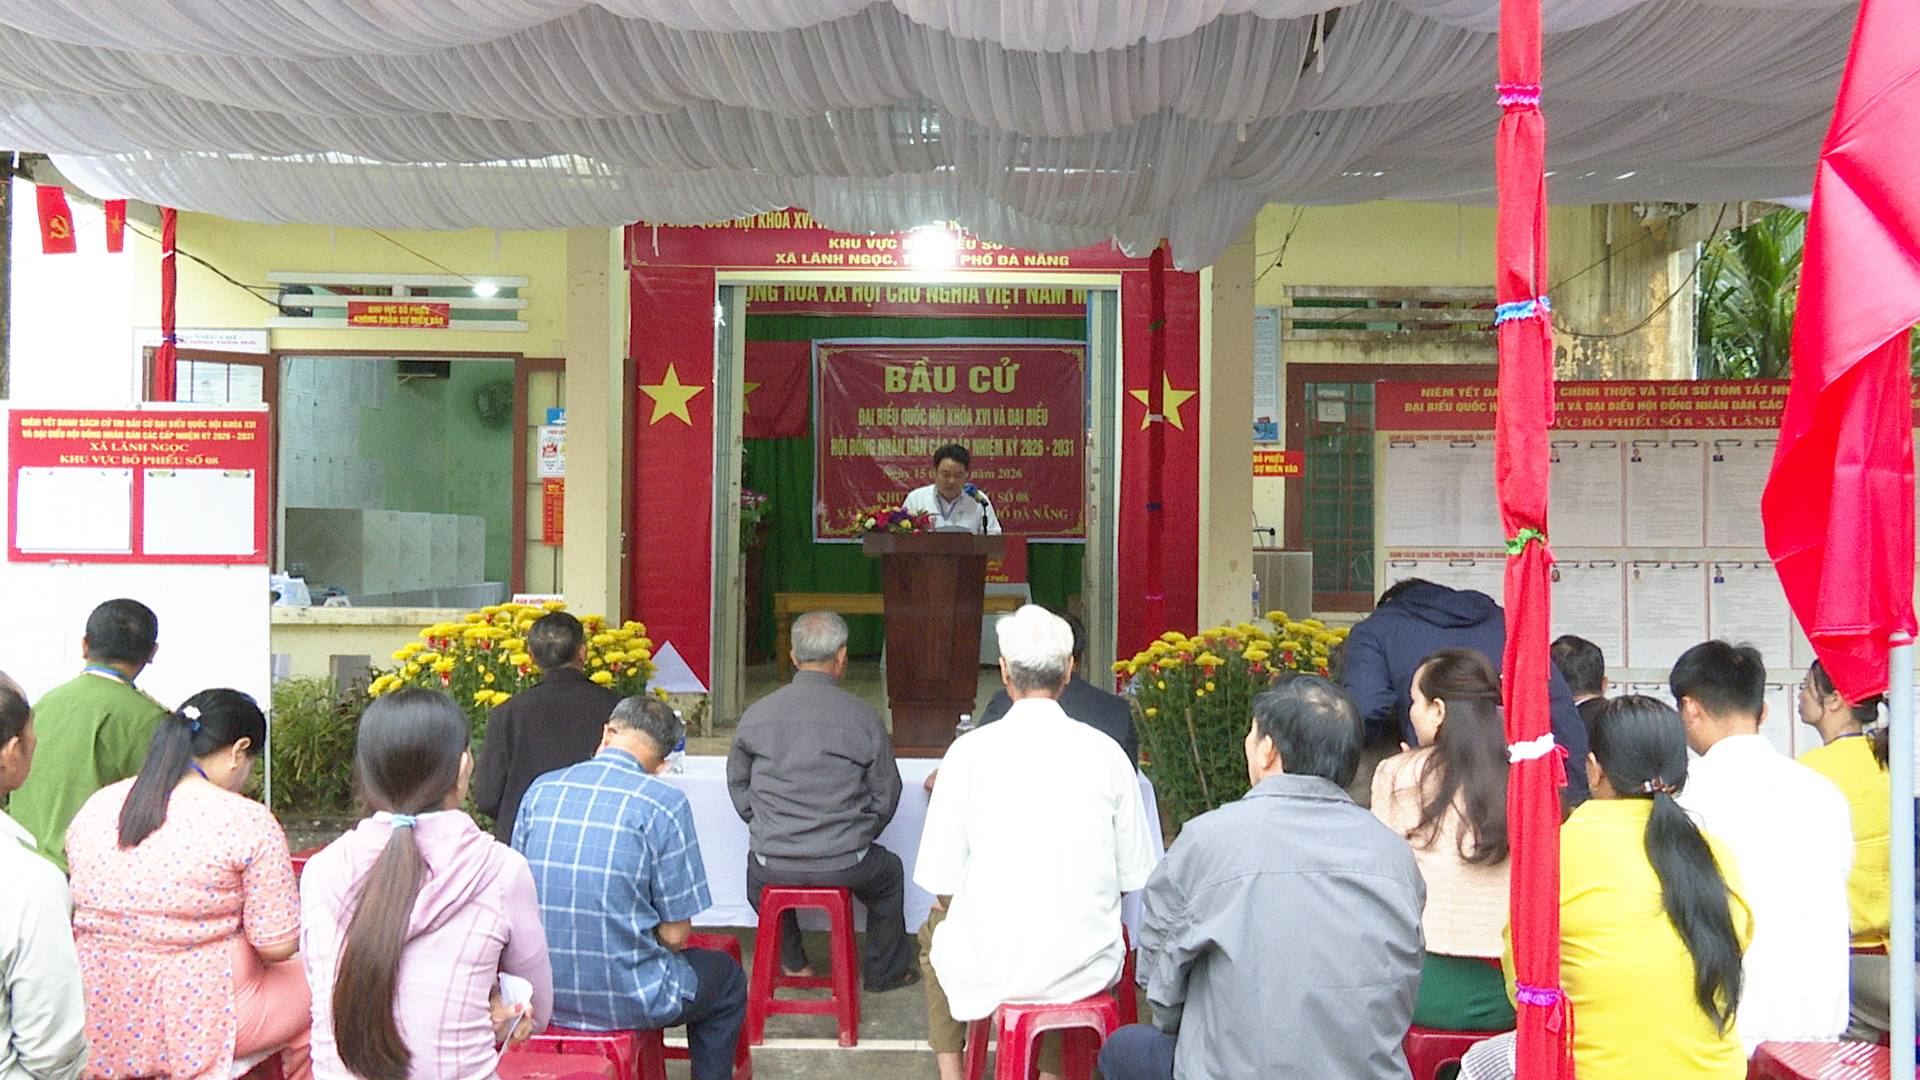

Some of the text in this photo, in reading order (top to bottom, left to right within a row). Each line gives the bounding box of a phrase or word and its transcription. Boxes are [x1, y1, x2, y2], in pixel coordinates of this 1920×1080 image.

[829, 238, 861, 249] KHU
[866, 237, 898, 251] VỰC
[775, 251, 797, 264] XÃ
[960, 251, 993, 266] PHỐ
[997, 253, 1020, 266] ĐÀ
[1026, 287, 1067, 304] NAM
[884, 356, 1021, 393] BẦU CỬ
[1421, 385, 1453, 397] NIÊM
[1458, 384, 1480, 397] YẾT
[1560, 384, 1600, 397] CHÍNH
[1604, 385, 1636, 396] THỨC
[1639, 385, 1656, 396] VÀ
[1661, 382, 1688, 396] TIỂU
[1712, 384, 1741, 395] TÓM
[1404, 401, 1424, 413] ĐẠI
[1427, 399, 1453, 412] BIỂU
[1456, 400, 1486, 412] QUỐC
[1567, 399, 1582, 411] VÀ
[1607, 398, 1634, 411] BIỂU
[1637, 400, 1657, 412] HỘI
[1760, 399, 1783, 410] CÁC
[858, 401, 1048, 430] ĐẠI BIỂU QUỐC HỘI KHÓA XVI VÀ ĐẠI BIỂU
[1556, 415, 1580, 428] ỰC
[1608, 412, 1656, 427] PHIẾU
[1660, 412, 1681, 427] SỐ
[90, 441, 189, 453] XÃ LÃNH NGỌC
[972, 434, 1004, 460] NHIỆM
[1020, 439, 1044, 456] 2026
[1052, 439, 1074, 456] 2031
[60, 451, 219, 465] KHU VỰC BỎ PHIẾU SỐ 08
[914, 468, 926, 479] 15
[997, 468, 1023, 479] 2026
[999, 488, 1014, 502] SỐ
